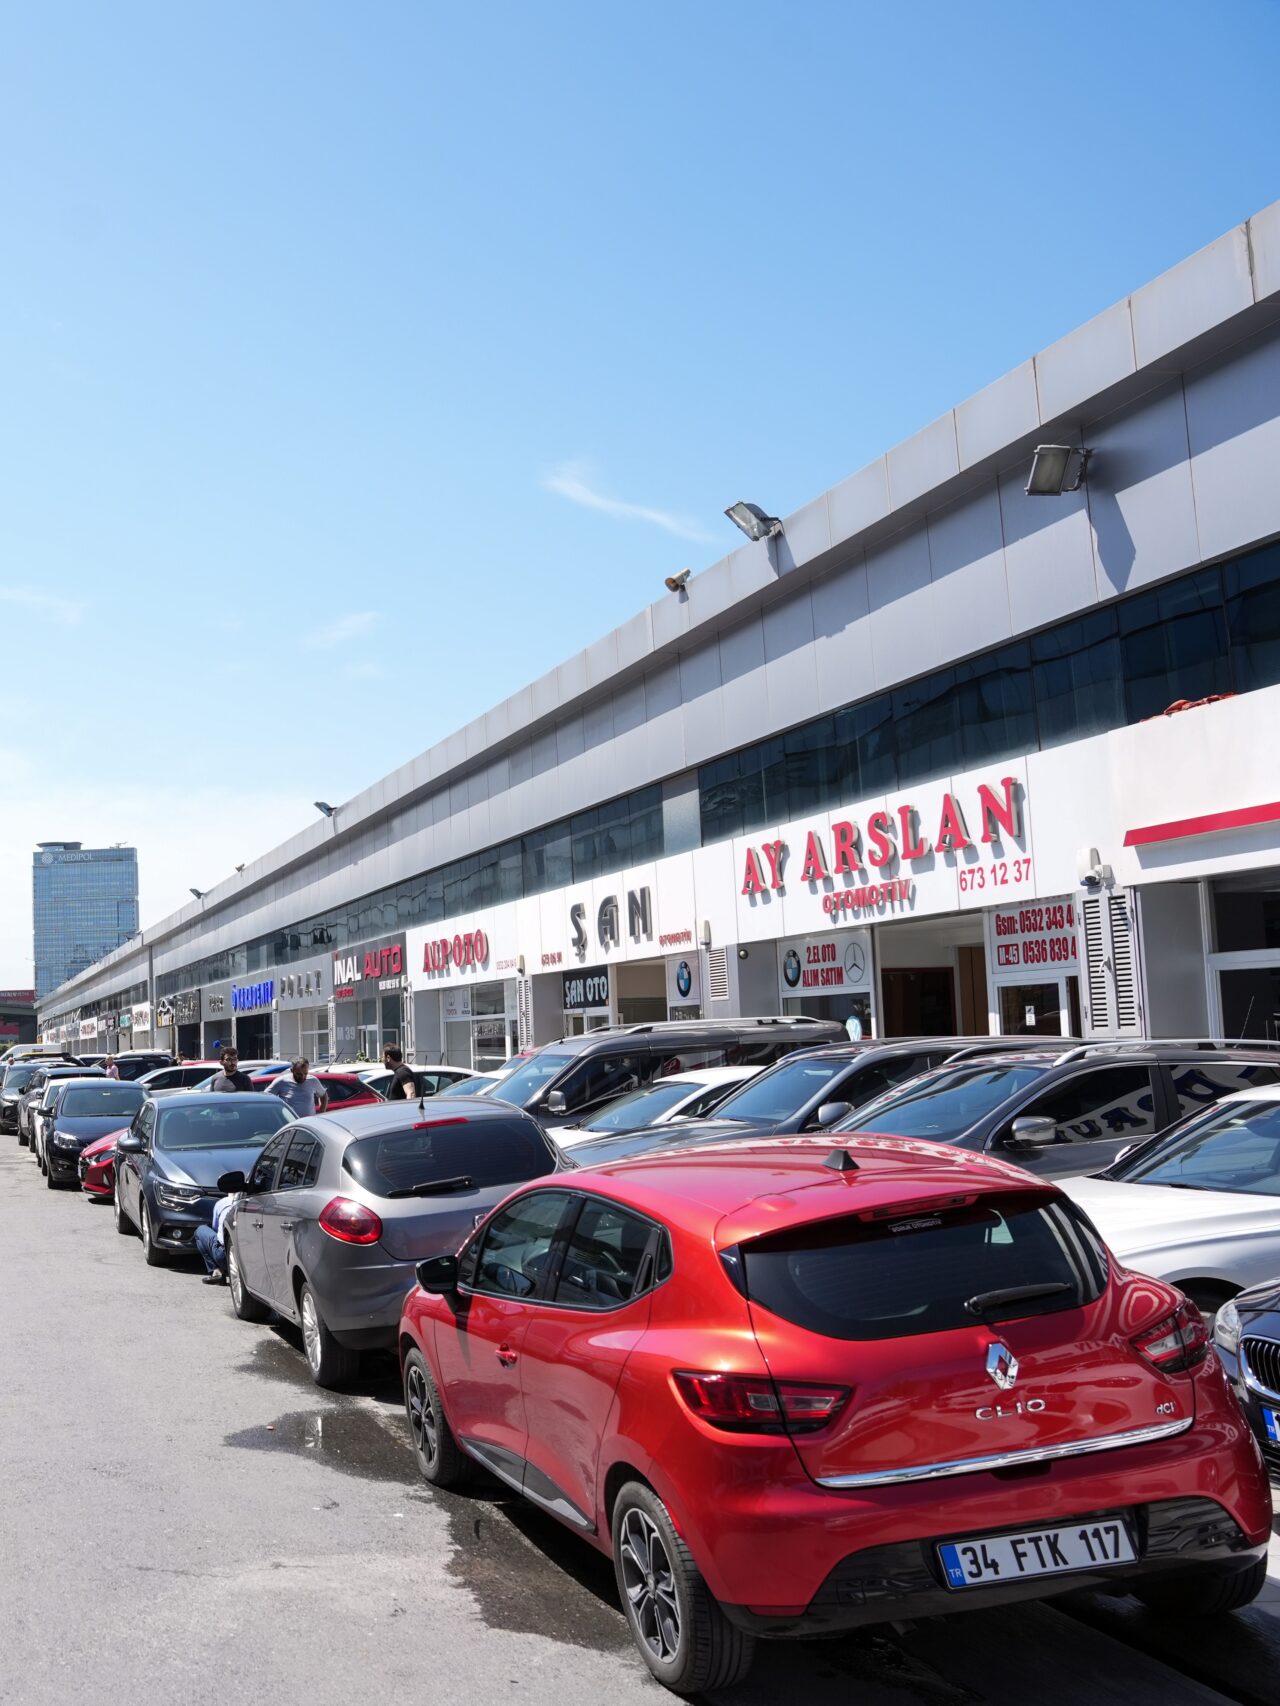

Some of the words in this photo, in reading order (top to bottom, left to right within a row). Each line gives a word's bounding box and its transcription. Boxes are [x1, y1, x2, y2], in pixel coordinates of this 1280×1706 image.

[741, 839, 785, 897] AY
[800, 777, 1021, 883] ARSLAN
[959, 867, 985, 892] 673
[990, 863, 1008, 887] 12
[1014, 858, 1032, 883] 37
[822, 875, 913, 914] OTOMOTİV
[570, 886, 652, 957] ŞAN
[995, 913, 1018, 936] Gsm:
[1019, 907, 1044, 934] 0532
[1045, 905, 1065, 931] 343
[363, 943, 403, 978] AUTO
[806, 945, 821, 964] 2.EL
[822, 942, 836, 963] OTO
[999, 946, 1019, 965] M-45
[1022, 938, 1048, 965] 0536
[1049, 936, 1069, 962] 839
[586, 975, 608, 1002] OTO
[802, 968, 819, 988] ALIM
[820, 966, 844, 986] SATIM
[337, 1027, 344, 1041] M
[345, 1026, 356, 1041] 39
[975, 1399, 1046, 1421] CLIO
[949, 1568, 962, 1579] TR
[961, 1543, 1000, 1579] 34
[1010, 1533, 1069, 1572] FTK
[1078, 1525, 1120, 1562] 117
